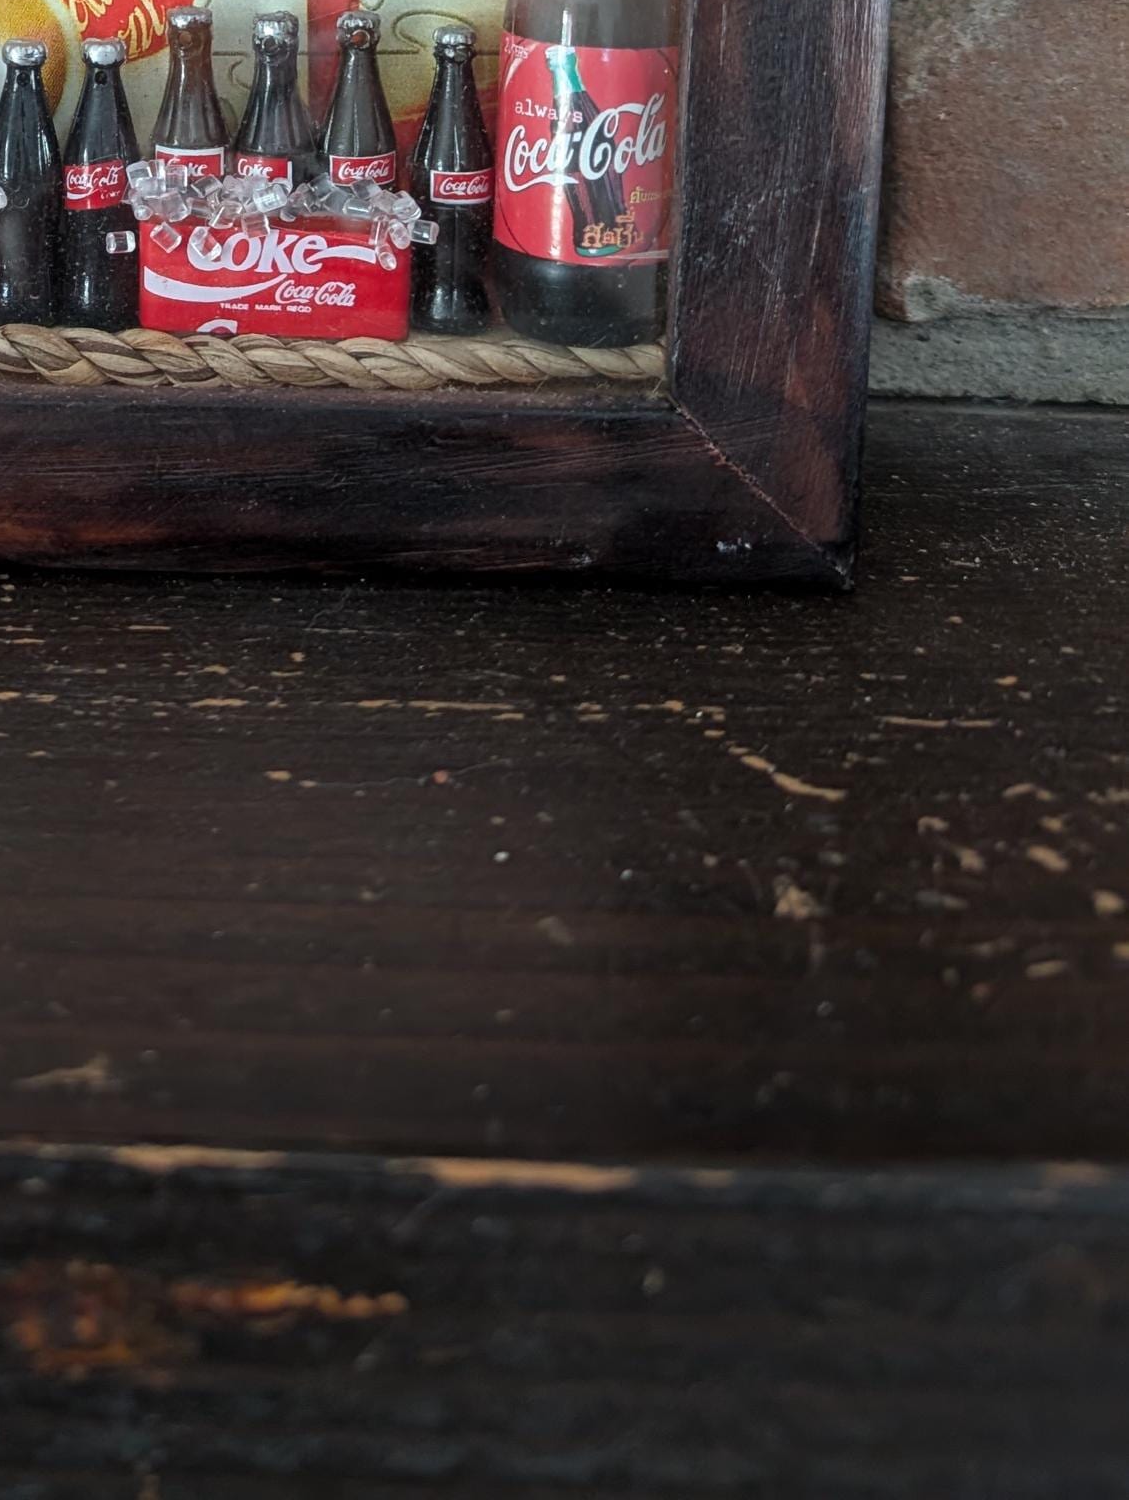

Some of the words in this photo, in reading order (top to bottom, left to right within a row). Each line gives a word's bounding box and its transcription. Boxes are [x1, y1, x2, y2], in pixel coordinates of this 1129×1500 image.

[503, 93, 667, 192] Coca-Cola
[237, 157, 273, 178] Coke
[337, 160, 390, 182] Coca-Cola
[438, 176, 490, 197] Coca-Cola
[187, 226, 330, 274] Coke
[275, 278, 356, 308] Coca-Cola
[255, 303, 282, 312] MARK
